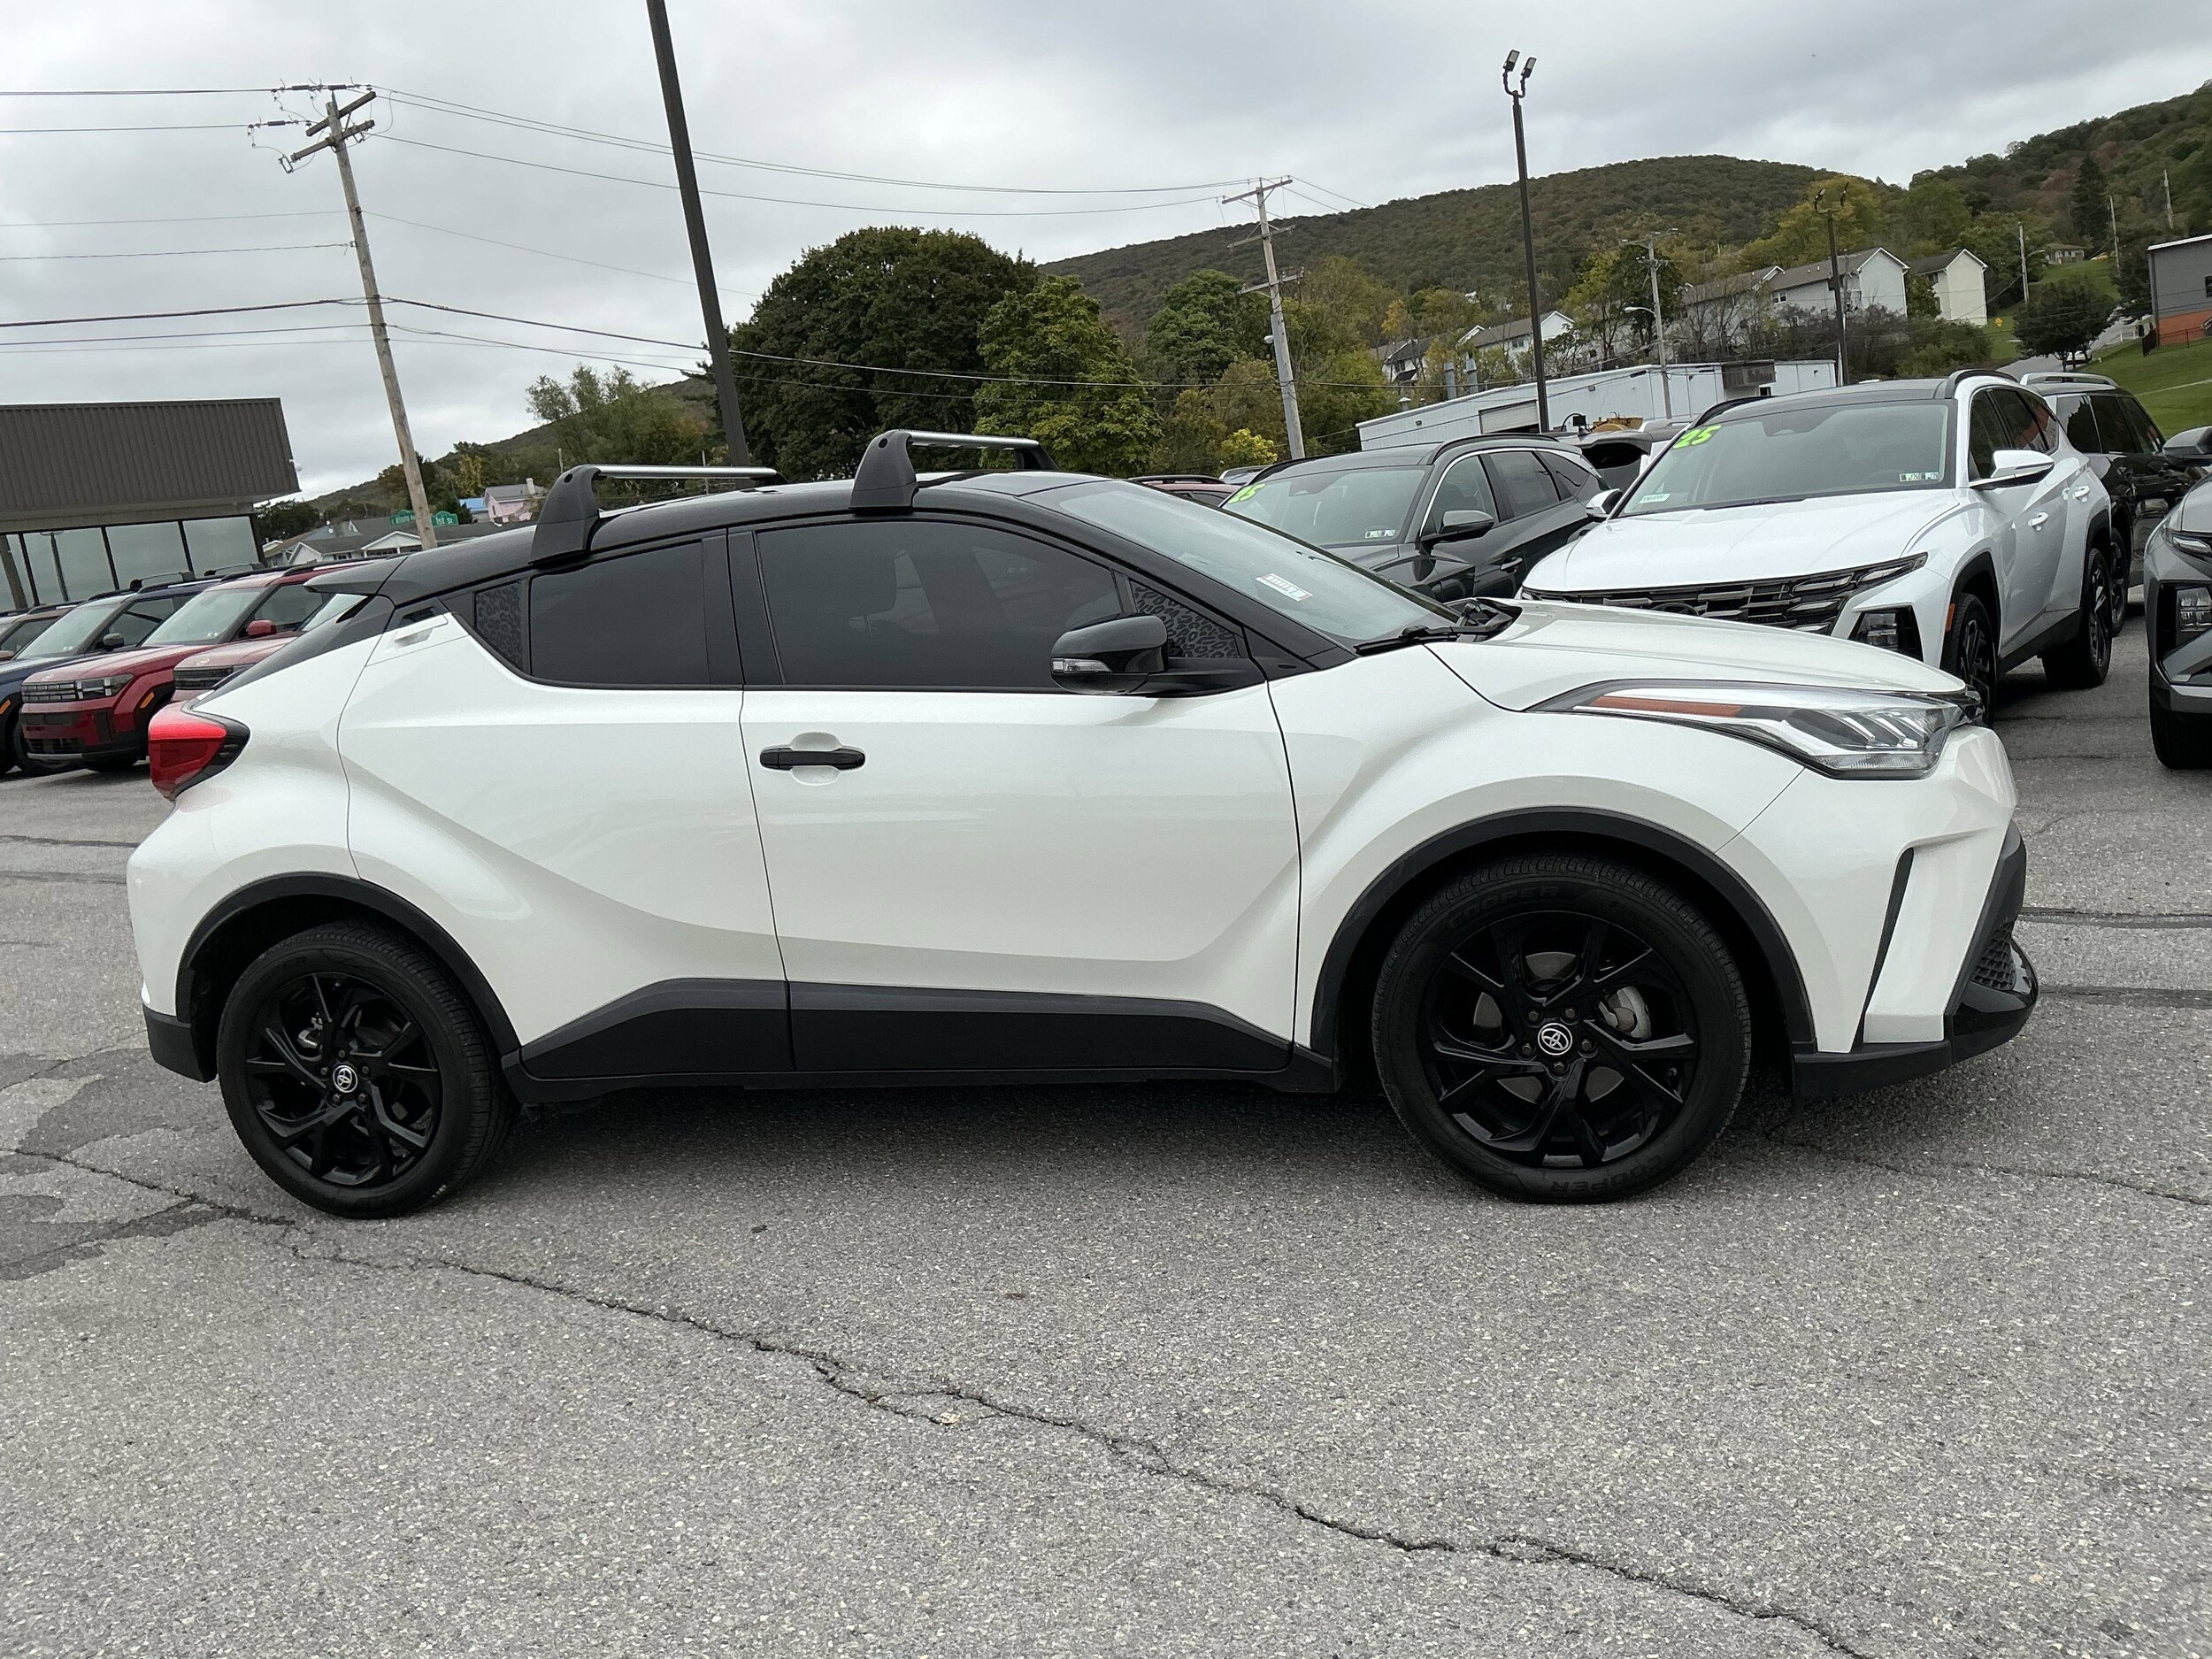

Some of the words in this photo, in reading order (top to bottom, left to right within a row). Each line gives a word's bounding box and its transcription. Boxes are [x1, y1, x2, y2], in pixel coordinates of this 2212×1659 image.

[1672, 424, 1723, 449] 25
[1448, 885, 1560, 928] COOPER
[1550, 1155, 1663, 1193] COOPER
